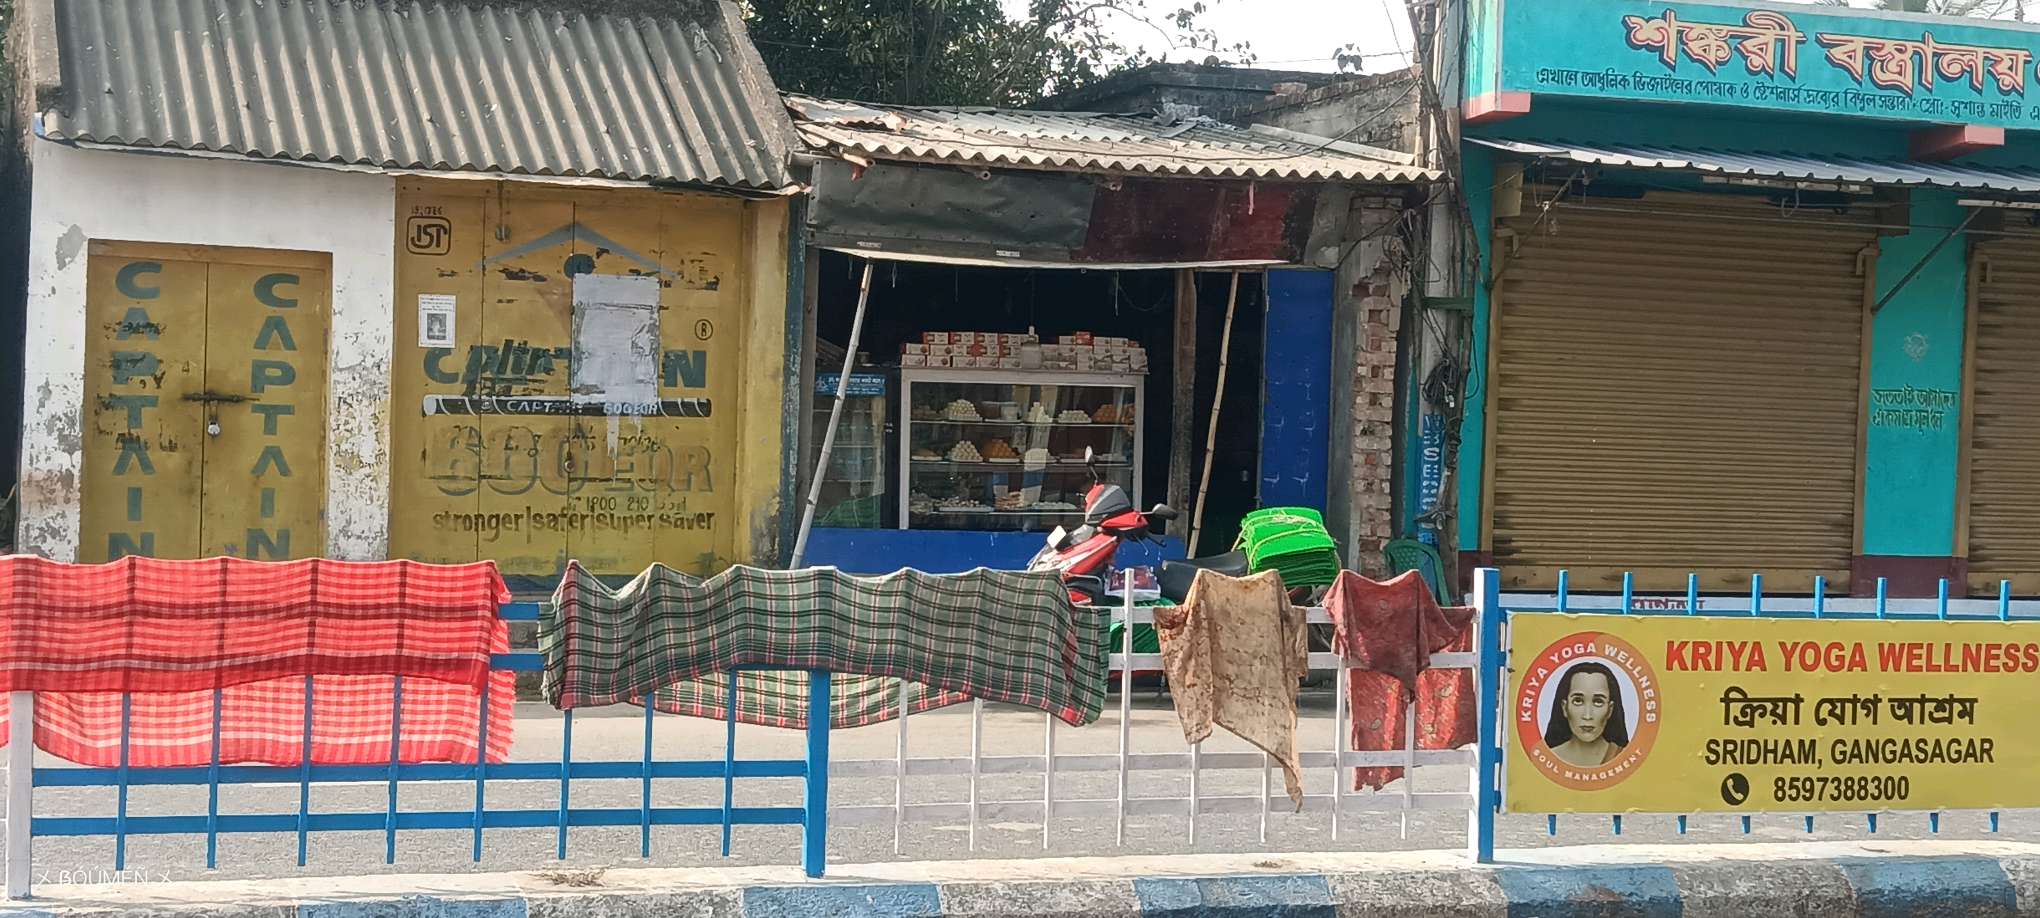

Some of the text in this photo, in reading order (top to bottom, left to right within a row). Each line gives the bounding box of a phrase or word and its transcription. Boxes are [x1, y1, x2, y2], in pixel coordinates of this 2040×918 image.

[1622, 9, 2034, 98] শঙ্করী বস্ত্রালয়
[1536, 68, 1578, 85] এখানে
[1581, 68, 1630, 92] আধুনিক
[1740, 81, 1750, 99] ও
[1989, 99, 2024, 120] মাইতি
[246, 273, 299, 560] CAPTAIN
[1666, 640, 2039, 673] KRIYA YOGA WELLNESS
[1521, 642, 1656, 723] KRIYA YOGA WELLNESS
[1720, 686, 1978, 727] ক্রিয়া যোগ আশ্রম
[1532, 748, 1643, 782] SOUL MANAGEMENT
[1704, 737, 1994, 767] SRIDHAM, GANGASAGAR
[1773, 777, 1910, 802] 8597388300
